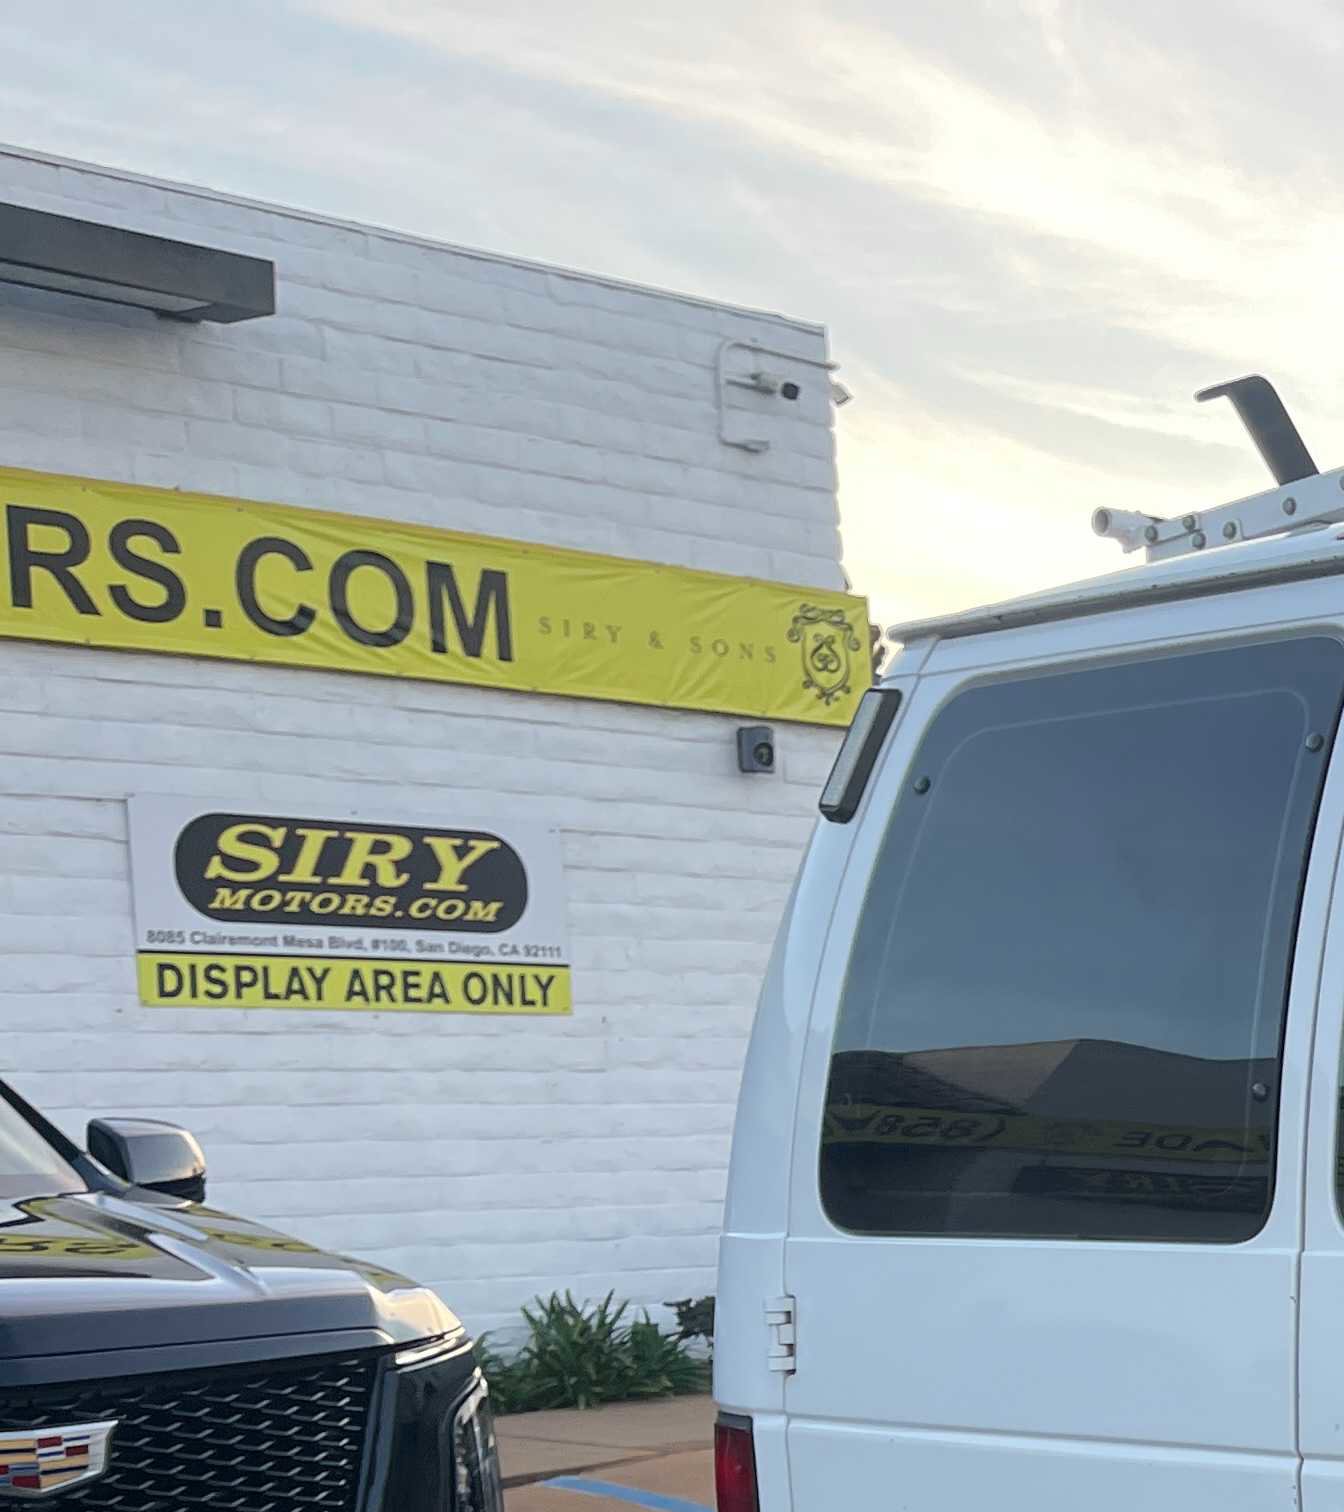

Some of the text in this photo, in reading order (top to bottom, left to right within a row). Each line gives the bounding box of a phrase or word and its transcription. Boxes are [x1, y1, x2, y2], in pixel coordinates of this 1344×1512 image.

[4, 504, 516, 663] RS.COM
[538, 616, 777, 664] SIRY & SONS
[204, 823, 501, 893] SIRY
[208, 887, 505, 923] MOTORS.COM
[146, 930, 185, 944] 8085
[189, 930, 279, 947] Clairemont
[282, 935, 324, 949] Mesa
[415, 939, 445, 954] San
[499, 943, 520, 957] CA
[522, 944, 562, 958] 92111
[157, 963, 556, 1008] DISPLAY AREA ONLY
